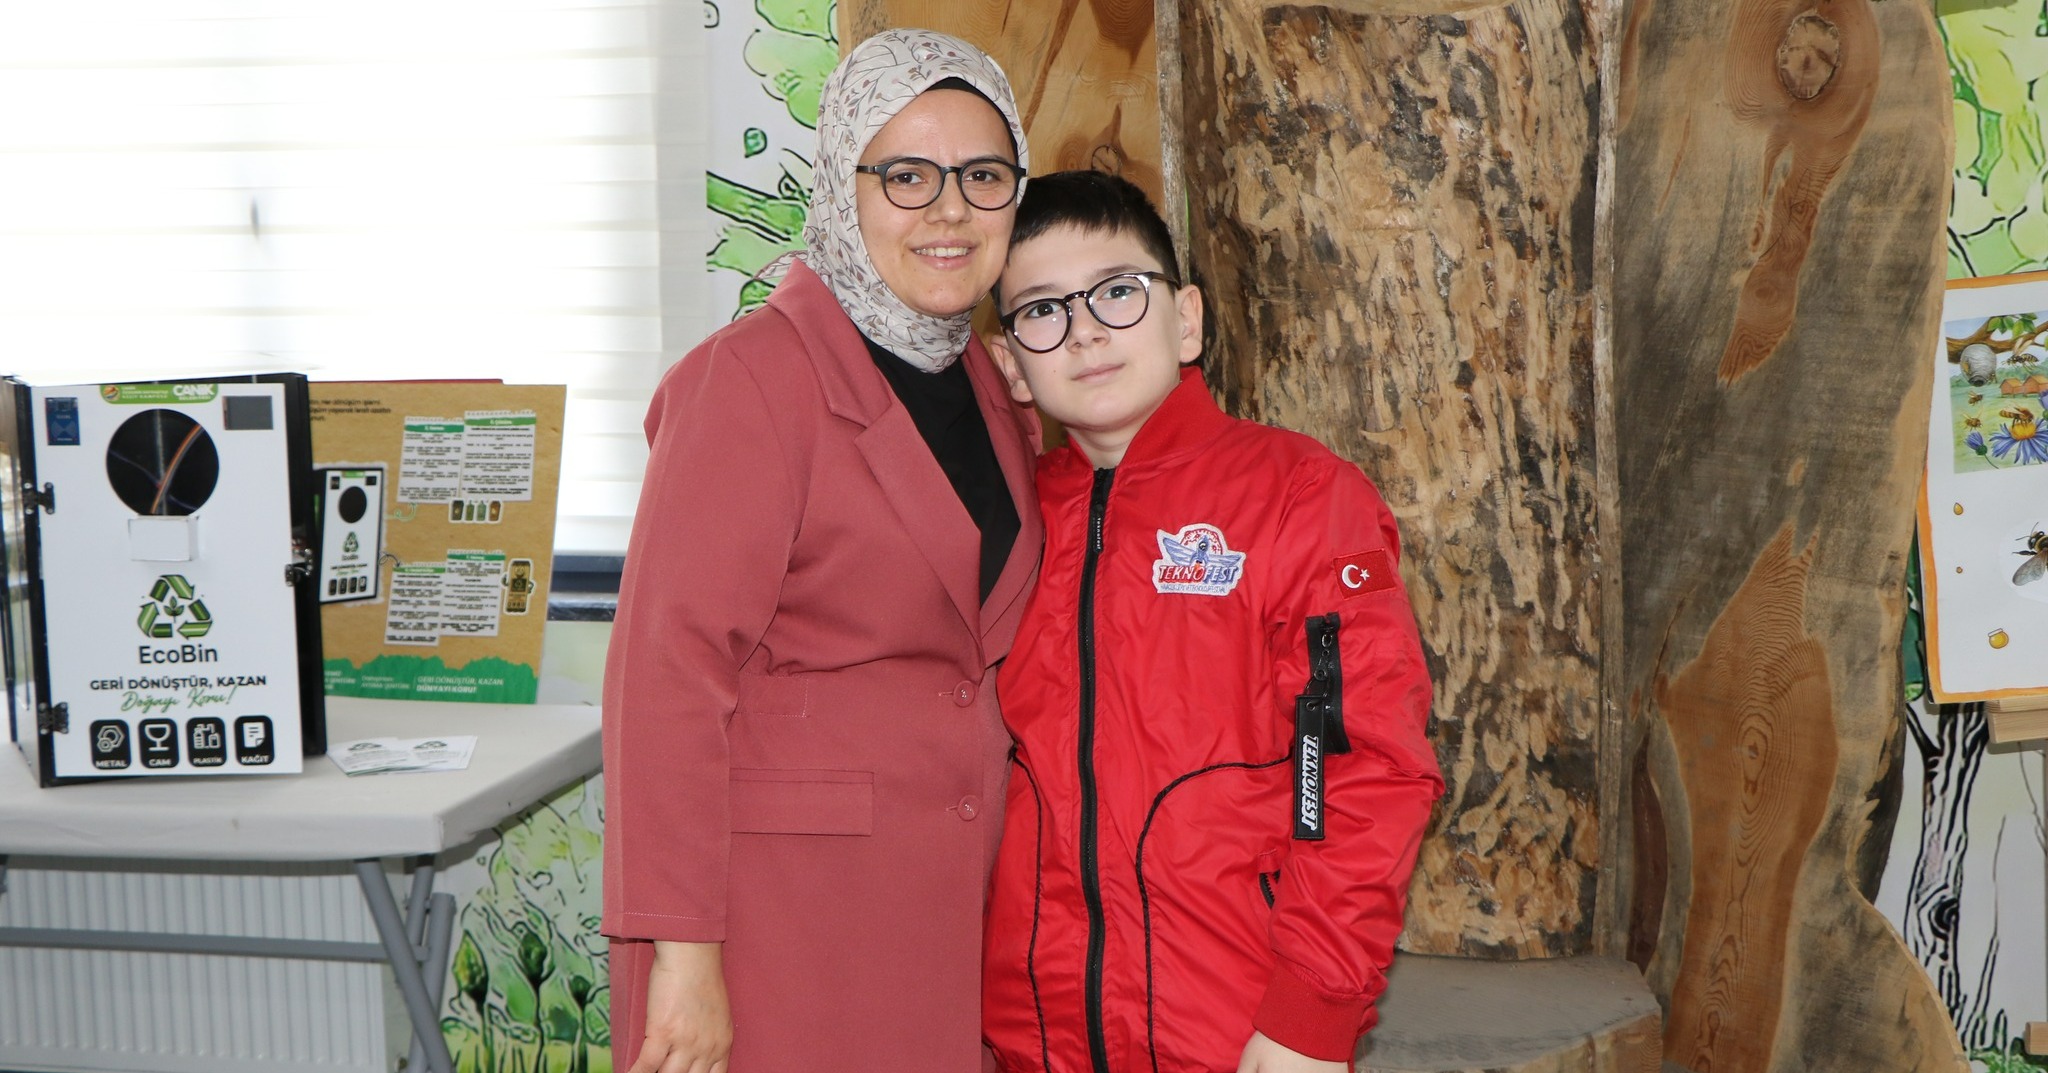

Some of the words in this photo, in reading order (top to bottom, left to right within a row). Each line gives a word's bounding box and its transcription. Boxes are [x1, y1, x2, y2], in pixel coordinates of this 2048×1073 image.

[1159, 565, 1238, 583] TEKNOFEST
[139, 644, 218, 664] EcoBin
[90, 676, 123, 690] GERİ
[128, 675, 212, 691] DÖNÜŞTÜR,
[217, 676, 266, 687] KAZAN
[187, 685, 238, 709] Koru!
[149, 758, 171, 766] CAM
[1302, 734, 1319, 831] TEKNOFEST
